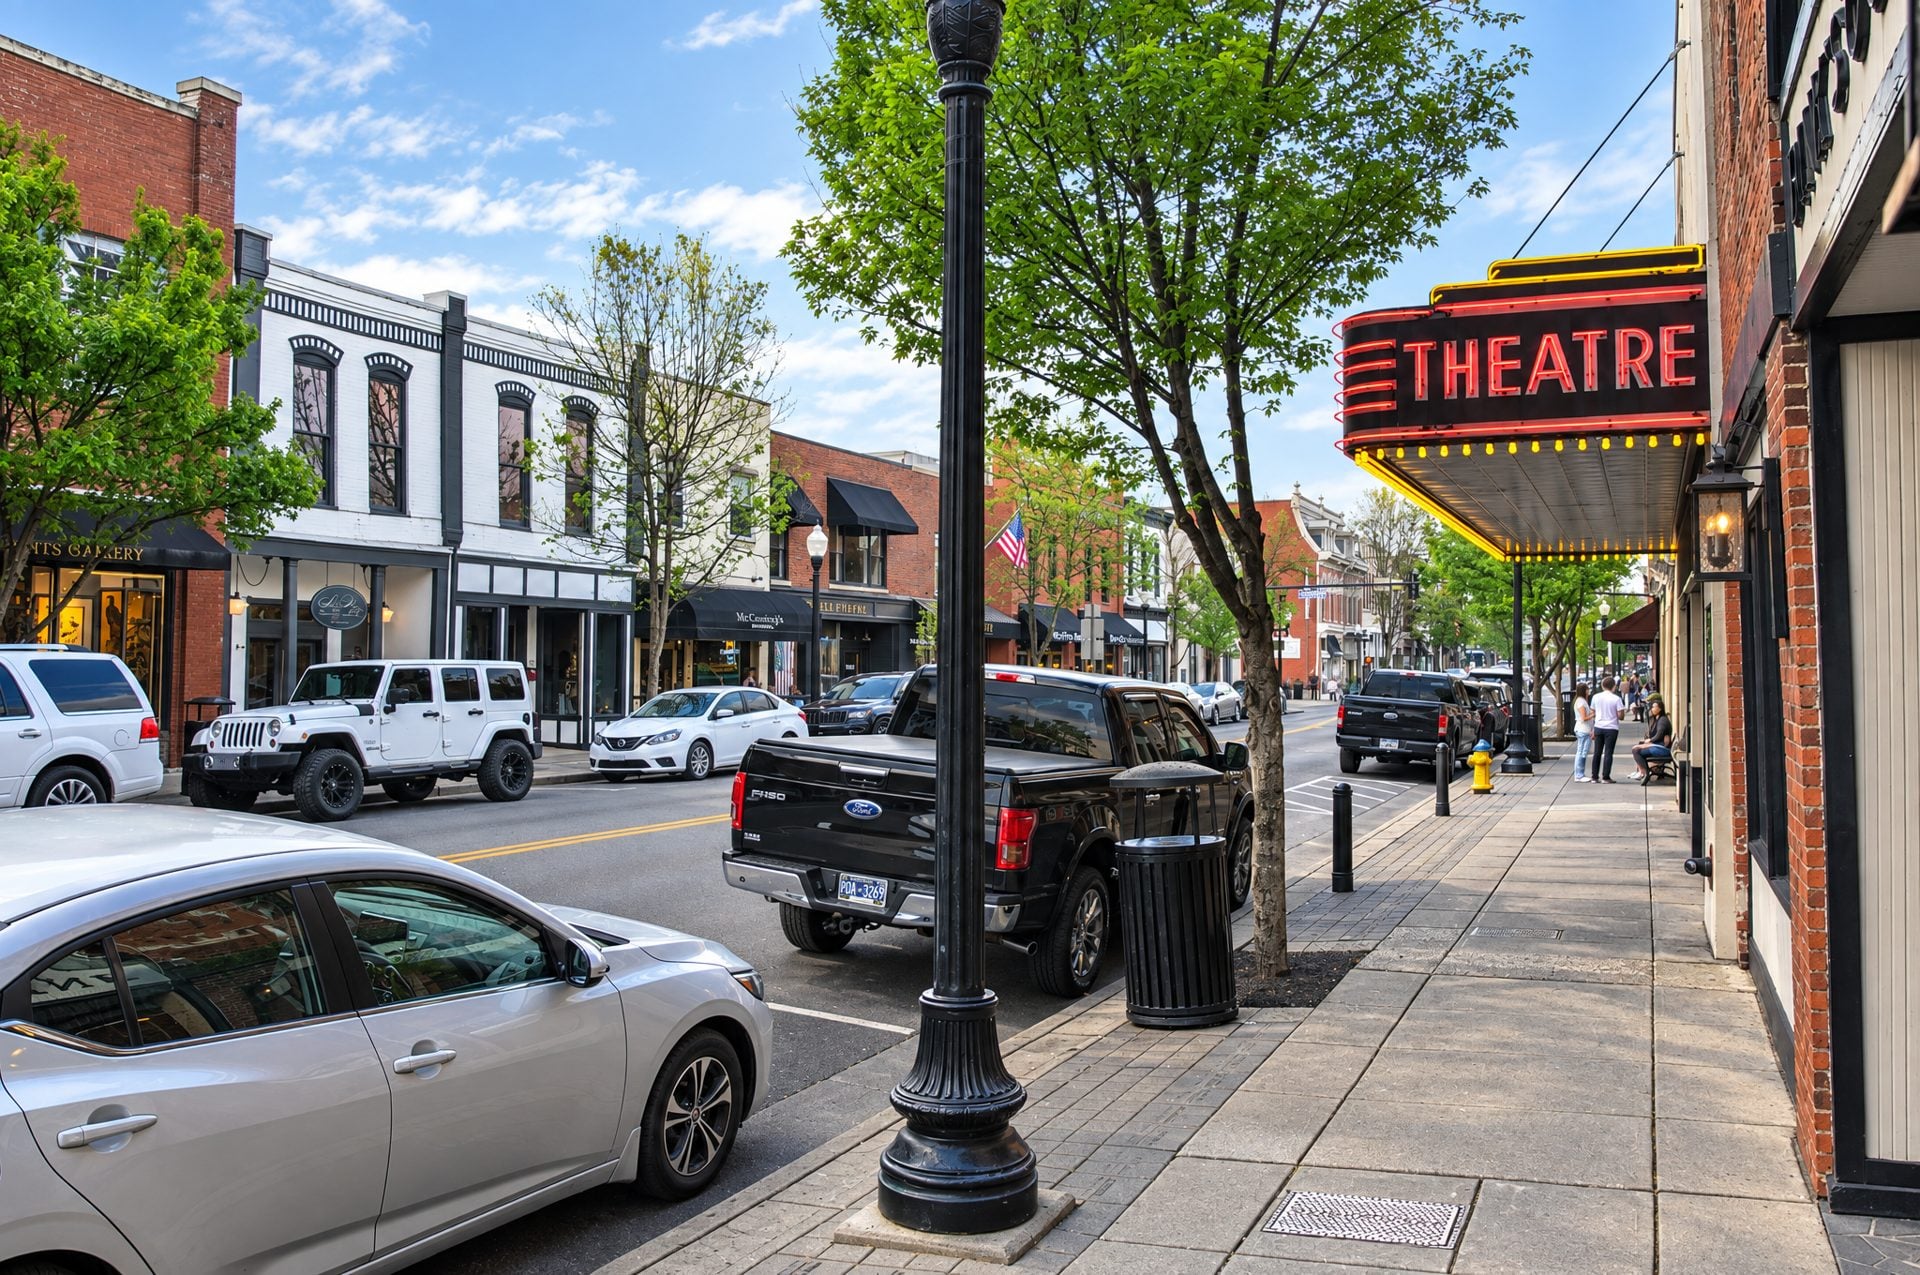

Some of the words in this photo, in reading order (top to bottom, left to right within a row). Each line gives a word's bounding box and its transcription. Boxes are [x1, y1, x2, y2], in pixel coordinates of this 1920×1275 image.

[1403, 324, 1696, 401] THEATRE
[68, 542, 144, 561] GAERY
[863, 883, 885, 900] 3269
